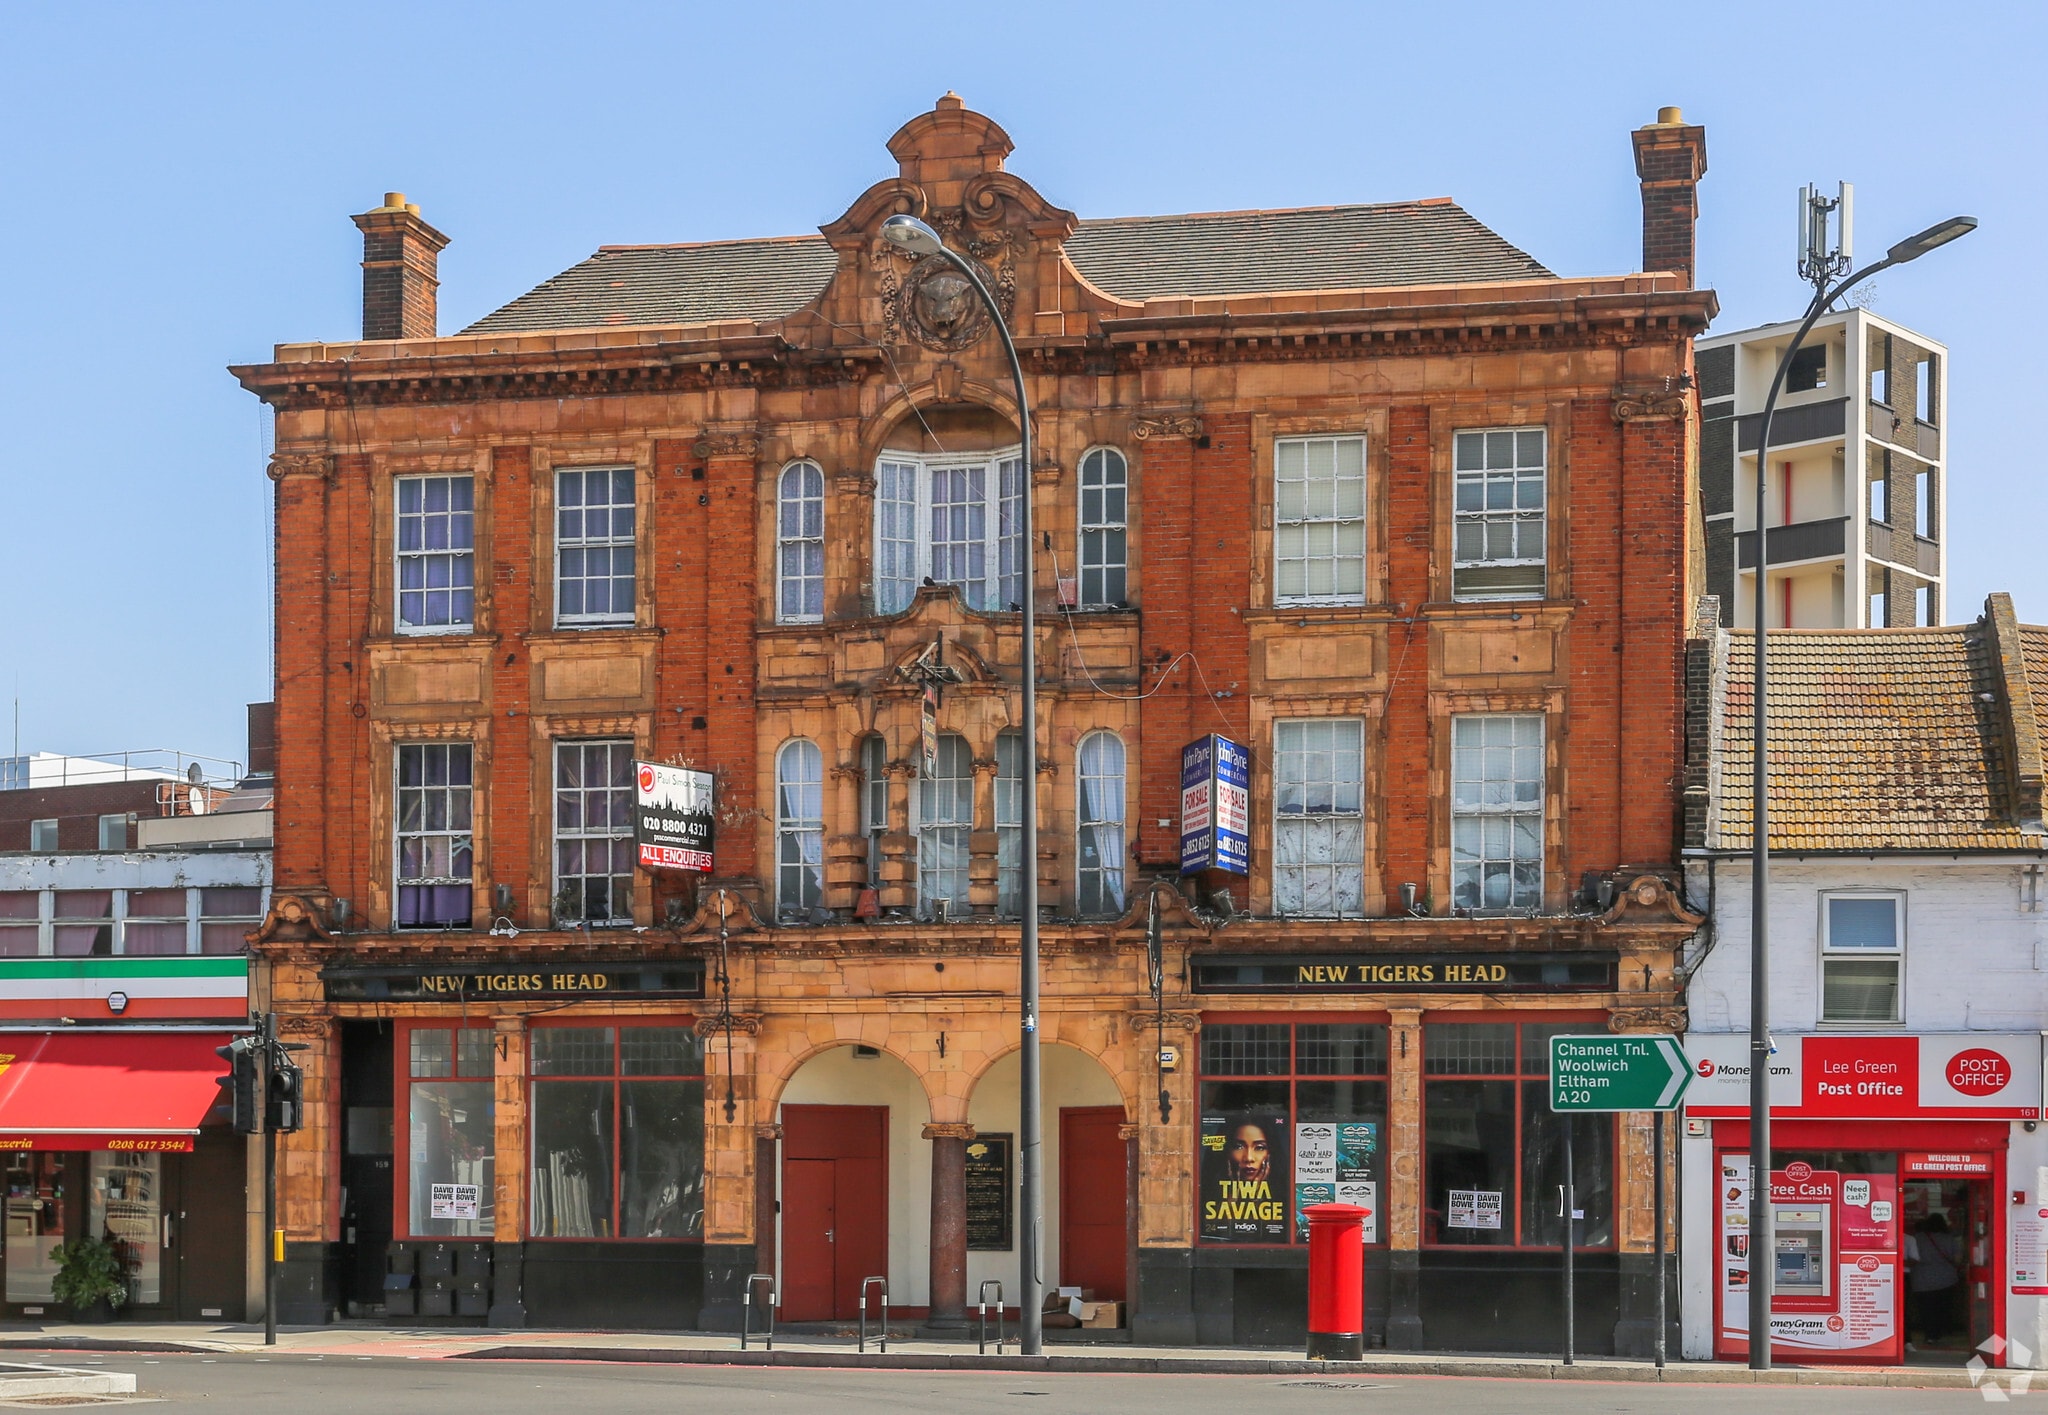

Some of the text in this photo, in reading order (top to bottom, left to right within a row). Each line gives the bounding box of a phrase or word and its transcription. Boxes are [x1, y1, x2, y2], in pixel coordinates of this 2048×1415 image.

[657, 771, 671, 785] Paul
[672, 774, 691, 788] Simon
[1217, 764, 1247, 783] COMMERCIAL
[1184, 785, 1208, 811] FOR SALE
[1219, 785, 1245, 811] FOR SALE
[643, 816, 707, 837] 020 8800 4321
[1187, 838, 1198, 855] 8852
[1198, 833, 1210, 852] 6125
[1223, 835, 1235, 853] 8852
[1235, 839, 1247, 857] 6125
[641, 847, 711, 867] ALL ENQUIRIES
[1299, 965, 1506, 983] NEW TIGERS HEAD
[421, 974, 607, 993] NEW TIGERS HEAD
[1558, 1043, 1650, 1056] Channel Tnl.
[1558, 1059, 1628, 1072] Woolwich
[1823, 1059, 1897, 1074] Lee Green
[1960, 1059, 1999, 1071] POST
[1559, 1075, 1610, 1087] Eltham
[1952, 1073, 2004, 1086] OFFICE
[1818, 1081, 1903, 1096] Post Office
[2020, 1109, 2035, 1117] 161
[108, 1140, 185, 1150] 0208 617 3544
[1314, 1142, 1318, 1150] I
[1927, 1154, 1960, 1162] WELCOME
[1912, 1162, 1923, 1170] LEE
[1923, 1163, 1945, 1171] GREEN
[1945, 1163, 1962, 1171] POST
[1218, 1180, 1272, 1199] TIWA
[1799, 1183, 1832, 1195] Cash
[1451, 1200, 1474, 1208] BOWIE
[1477, 1194, 1500, 1202] DAVID
[1205, 1200, 1283, 1220] SAVAGE
[1477, 1201, 1500, 1209] BOWIE
[1770, 1319, 1823, 1329] oneyGram
[1778, 1328, 1800, 1336] Money
